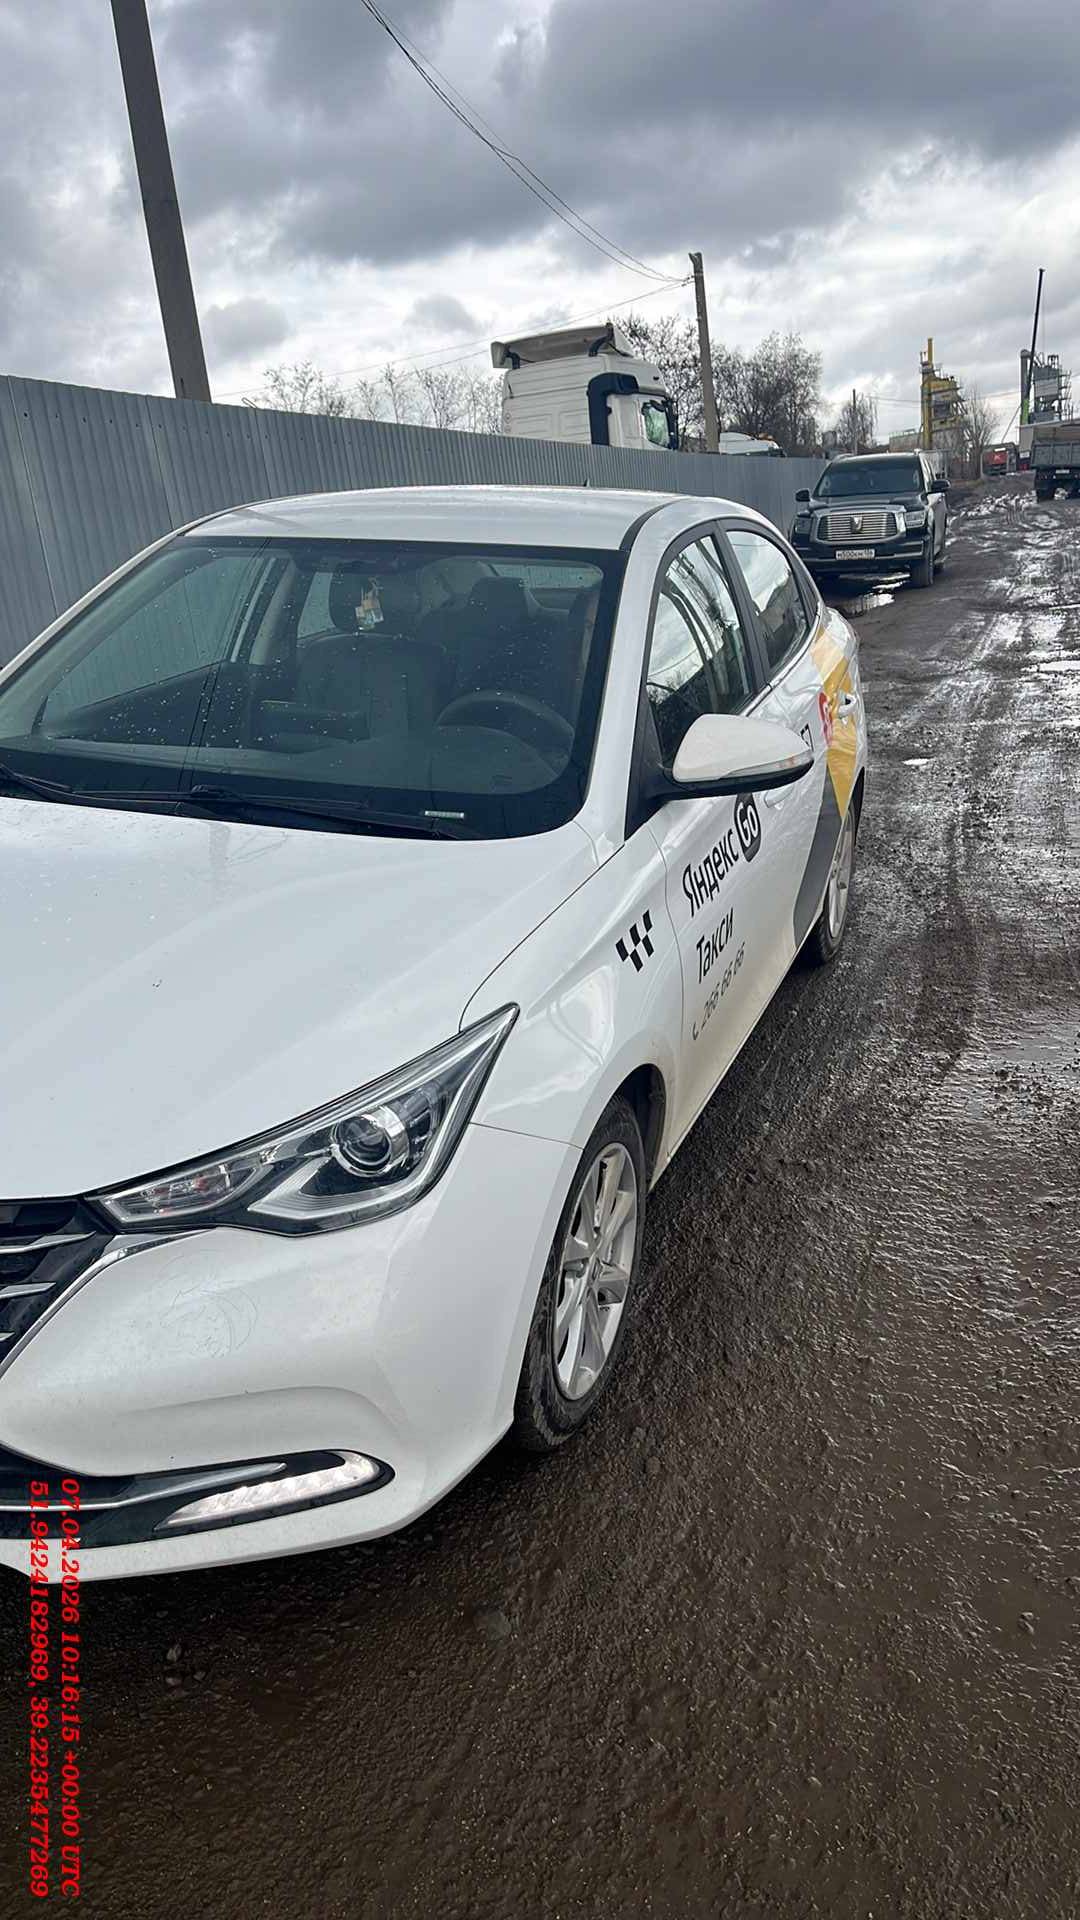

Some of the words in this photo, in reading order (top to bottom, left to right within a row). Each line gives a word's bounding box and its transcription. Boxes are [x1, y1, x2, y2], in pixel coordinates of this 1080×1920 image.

[682, 828, 739, 918] Яндекс
[736, 802, 759, 848] Go
[696, 907, 734, 984] Такси
